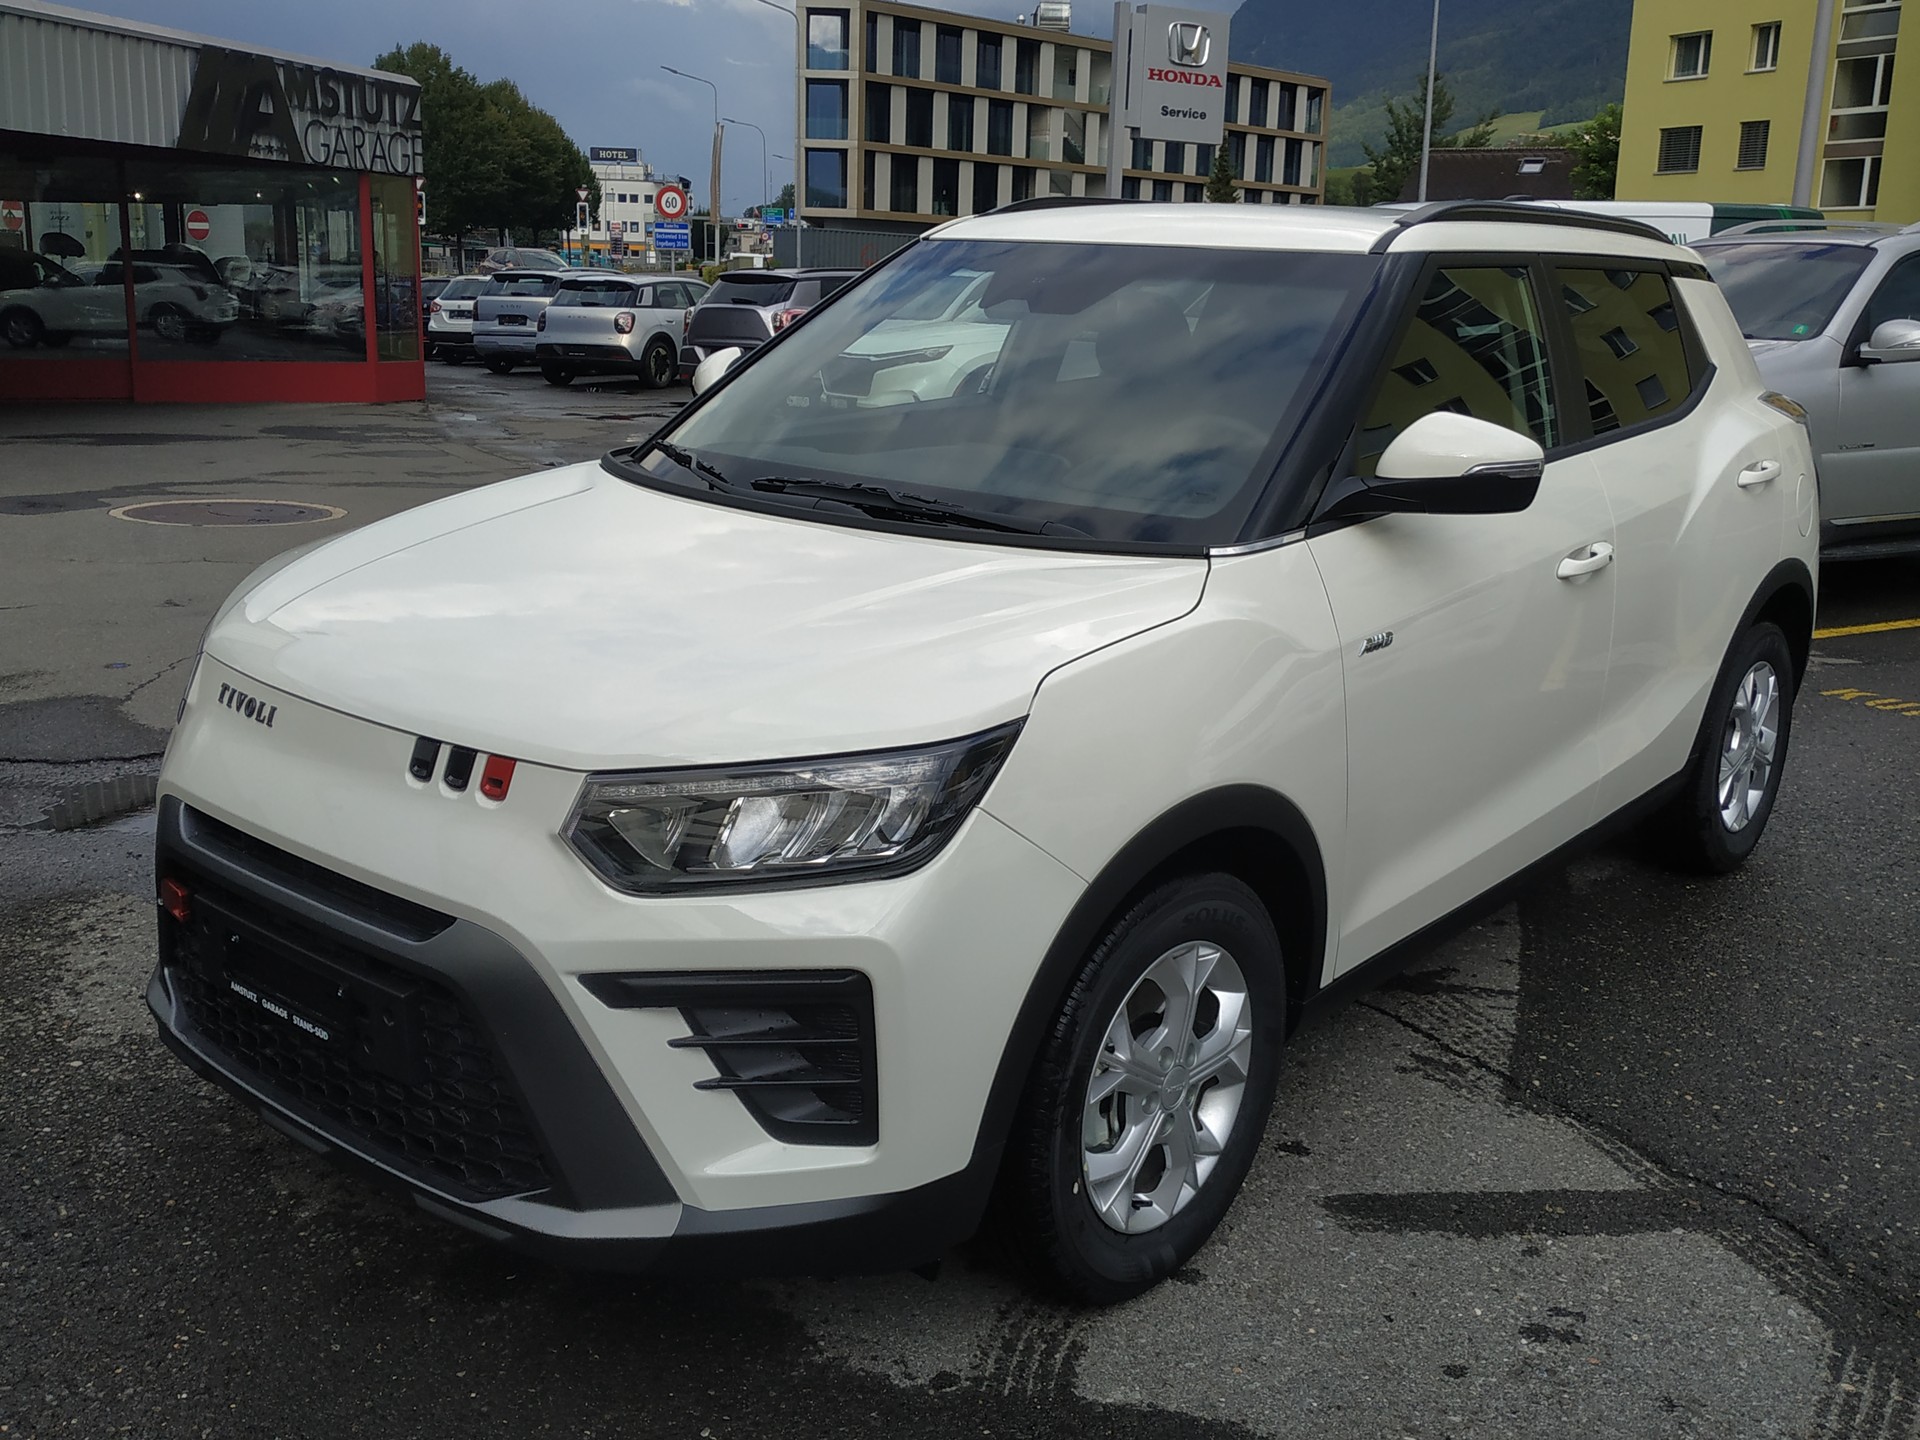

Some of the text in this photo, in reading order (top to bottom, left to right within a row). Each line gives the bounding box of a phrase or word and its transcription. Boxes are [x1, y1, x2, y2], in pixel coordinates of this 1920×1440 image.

[1147, 67, 1223, 88] HONDA
[1160, 105, 1207, 120] Service
[303, 118, 424, 176] GARAGE
[599, 150, 628, 159] HOTEL
[664, 196, 678, 209] 60
[217, 681, 278, 728] TIVOLI
[230, 981, 258, 1003] AMSTUTZ
[261, 998, 289, 1019] GARAGE
